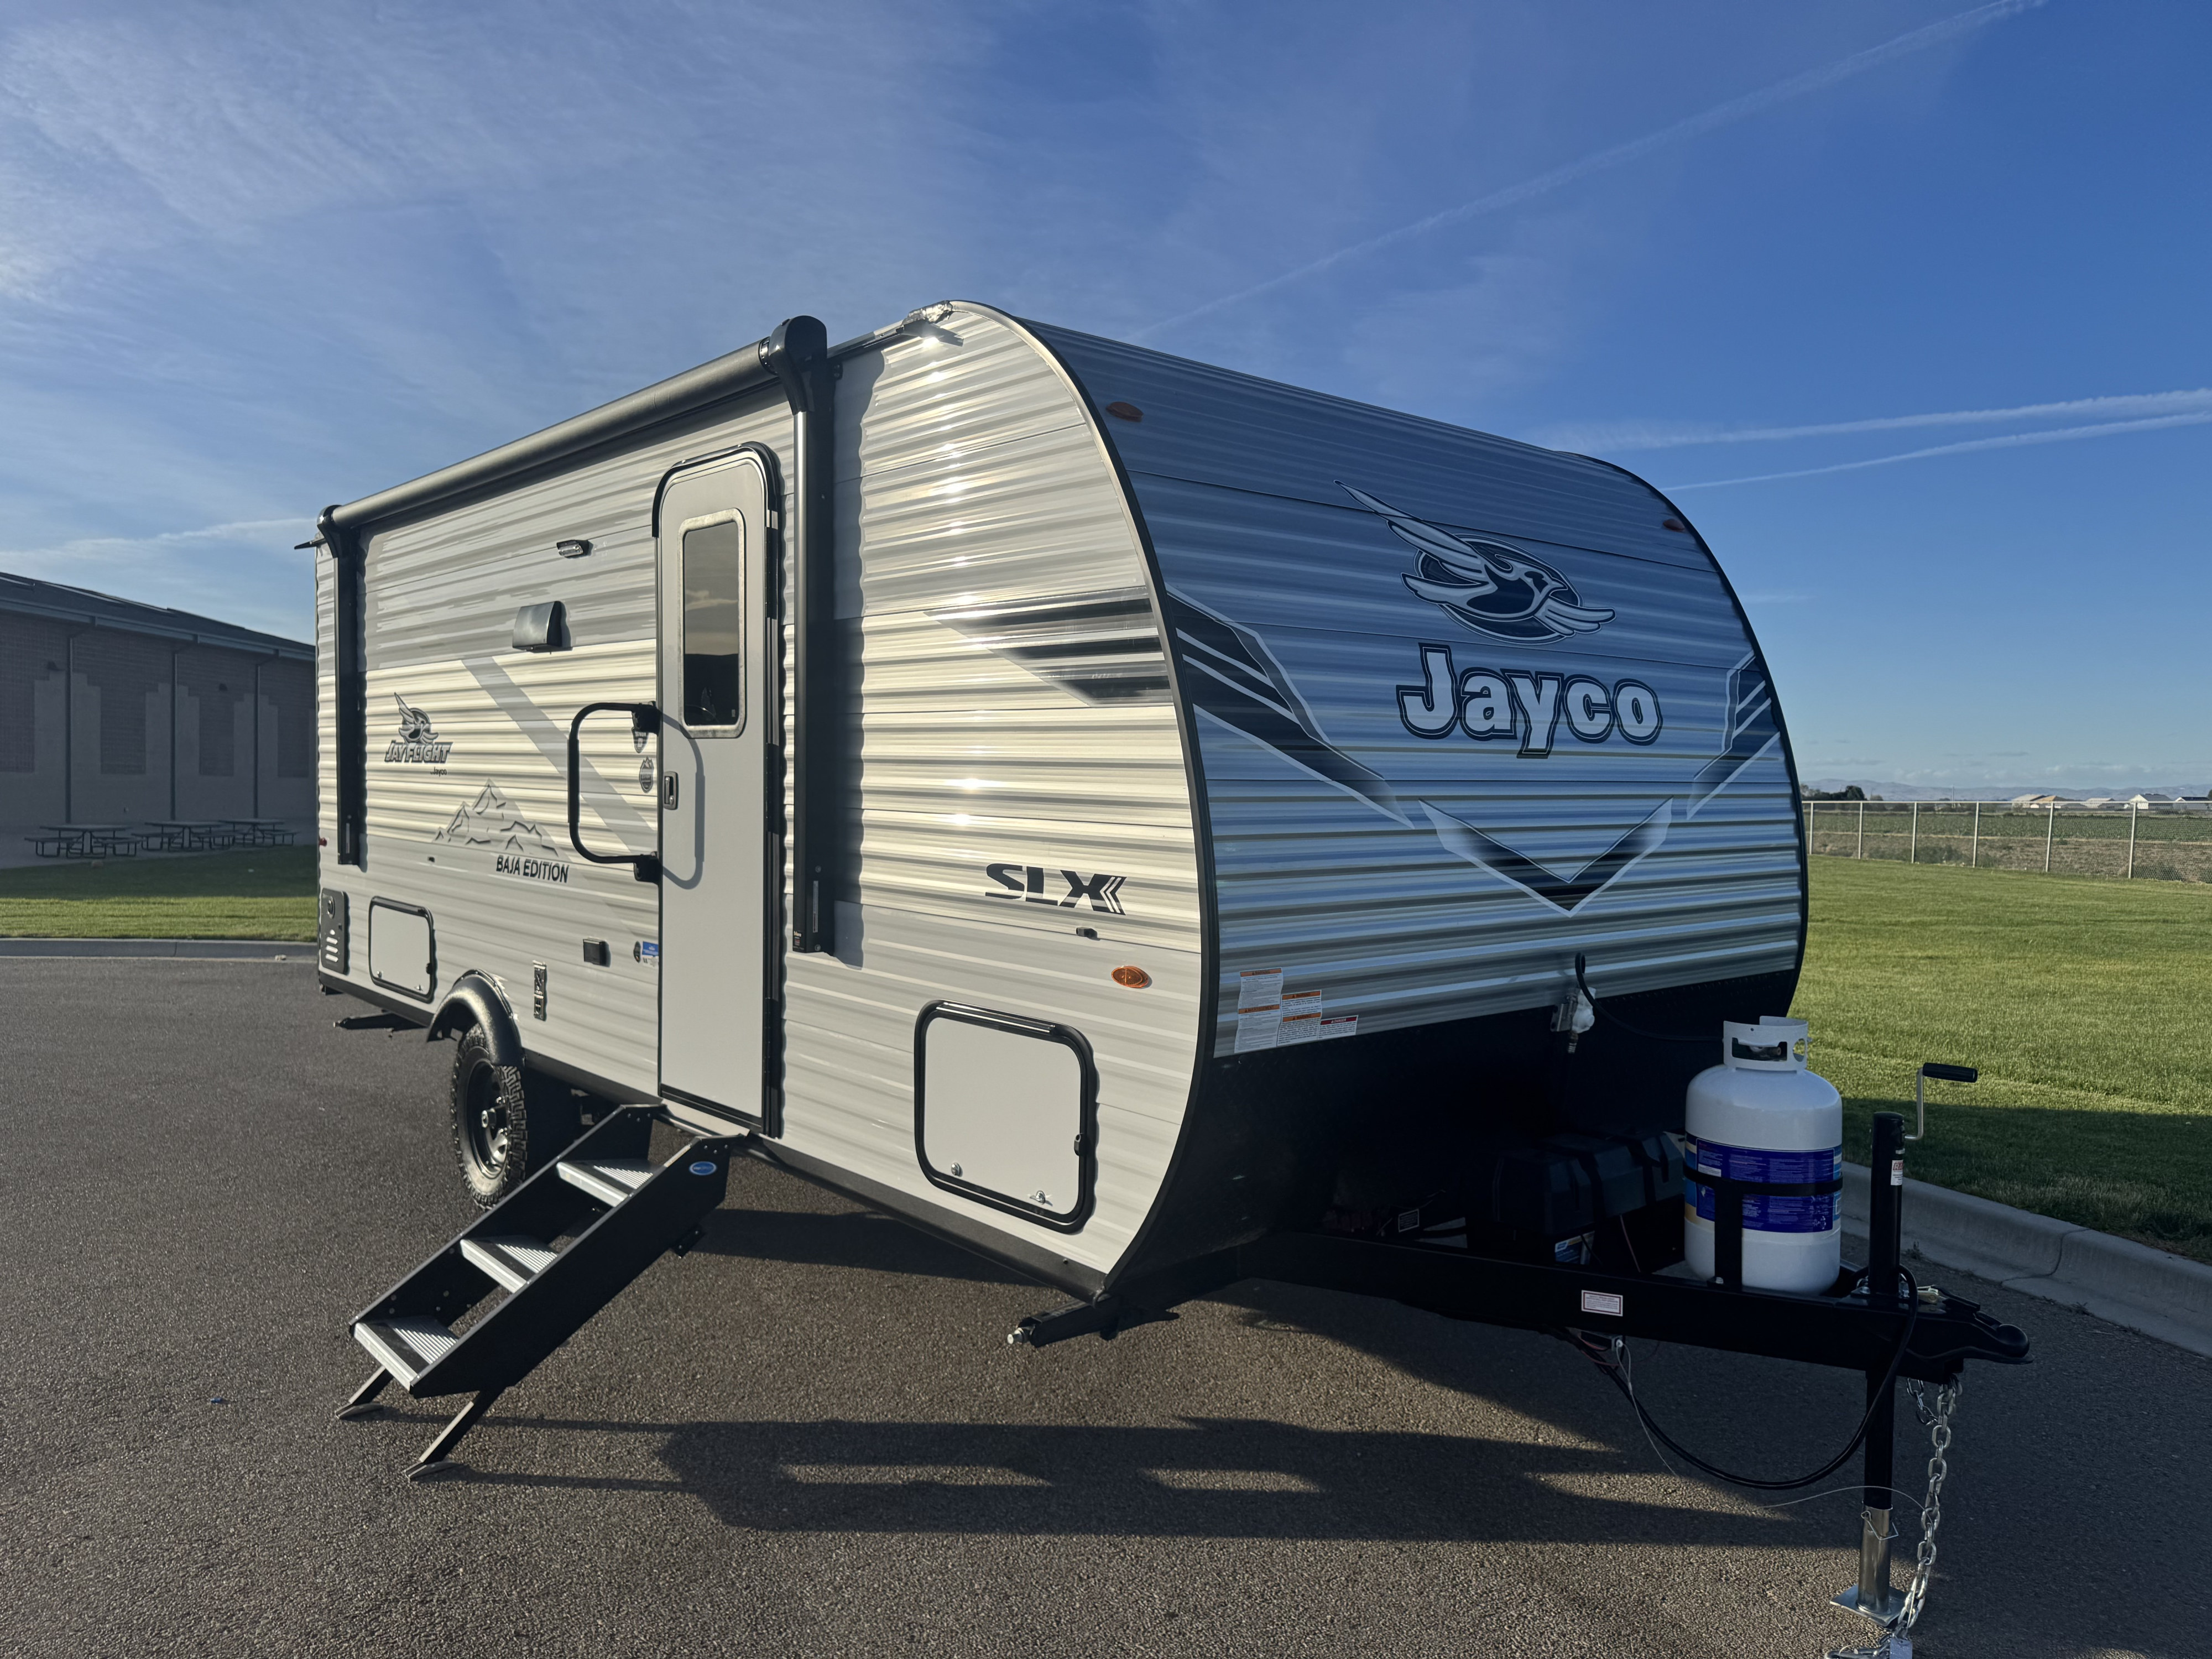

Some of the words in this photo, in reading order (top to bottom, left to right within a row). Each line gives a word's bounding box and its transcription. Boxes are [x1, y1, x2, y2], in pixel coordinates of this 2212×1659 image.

[1396, 643, 1663, 758] Jayco
[496, 854, 520, 875] BAJA
[523, 859, 570, 883] EDITION
[985, 863, 1128, 915] SLX
